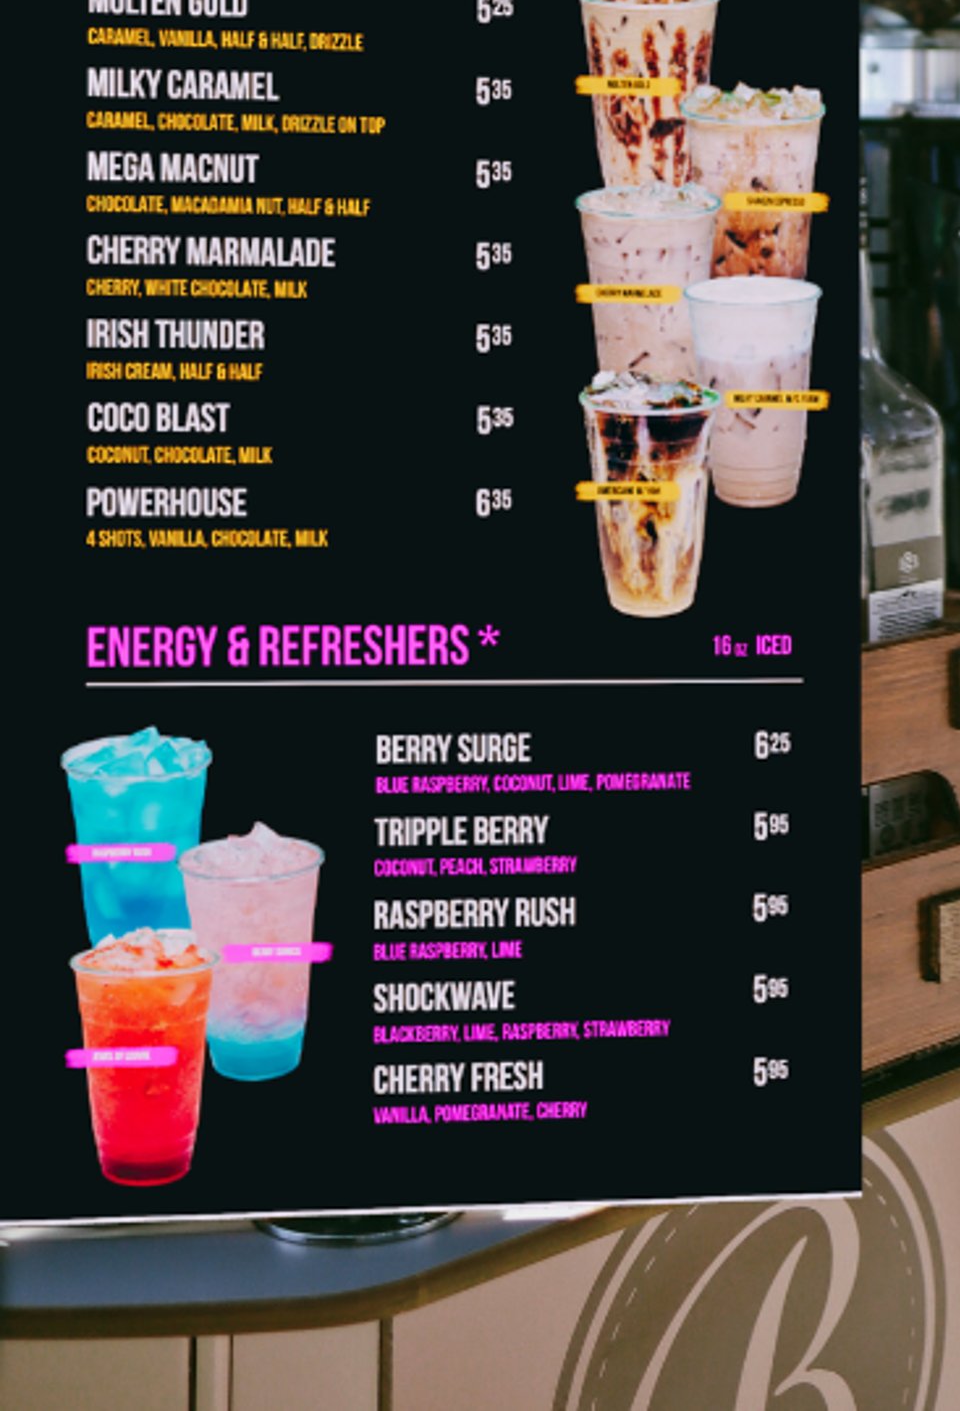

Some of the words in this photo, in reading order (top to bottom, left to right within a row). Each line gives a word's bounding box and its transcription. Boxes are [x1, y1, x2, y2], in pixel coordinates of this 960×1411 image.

[88, 27, 155, 47] CARAMEL,
[159, 30, 218, 49] VANILLA,
[221, 31, 254, 48] HALF
[258, 31, 268, 49] &
[270, 32, 306, 51] HALF,
[309, 32, 363, 51] DRIZZLE
[88, 67, 162, 99] MILKY
[167, 70, 280, 101] CARAMEL
[476, 77, 512, 105] 535
[86, 111, 155, 131] CARAMEL,
[158, 112, 238, 132] CHOCOLATE,
[241, 114, 278, 134] MILK,
[282, 115, 335, 133] DRIZZLE
[338, 116, 356, 133] ON
[359, 117, 385, 134] TOP
[88, 151, 155, 182] MEGA
[160, 153, 259, 183] MACNUT
[476, 159, 512, 188] 535
[86, 195, 168, 214] CHOCOLATE,
[171, 196, 253, 214] MACADAMIA
[256, 197, 285, 215] NUT,
[288, 198, 322, 215] HALF
[324, 198, 335, 215] &
[337, 198, 370, 216] HALF
[87, 235, 181, 264] CHERRY
[186, 237, 335, 267] MARMALADE
[476, 242, 512, 270] 535
[86, 278, 142, 297] CHERRY,
[144, 279, 188, 296] WHITE
[190, 279, 271, 298] CHOCOLATE,
[274, 280, 307, 298] MILK
[87, 319, 149, 348] IRISH
[154, 319, 264, 349] THUNDER
[476, 324, 512, 353] 535
[86, 362, 123, 379] IRISH
[125, 362, 176, 381] CREAM,
[180, 363, 213, 380] HALF
[217, 363, 226, 380] &
[228, 363, 262, 380] HALF
[88, 402, 149, 432] COCO
[156, 402, 230, 432] BLAST
[477, 406, 514, 435] 535
[87, 446, 151, 463] COCONUT,
[154, 446, 236, 464] CHOCOLATE,
[238, 447, 272, 464] MILK
[87, 487, 247, 517] POWERHOUSE
[476, 488, 512, 517] 635
[86, 530, 96, 546] 4
[99, 529, 146, 547] SHOTS,
[149, 530, 208, 548] VANILLA,
[211, 529, 291, 548] CHOCOLATE,
[295, 530, 328, 547] MILK
[87, 625, 218, 668] ENERGY
[228, 625, 250, 667] &
[259, 624, 469, 666] REFRESHERS
[756, 634, 792, 655] ICED
[377, 734, 452, 764] BERRY
[458, 733, 531, 763] SURGE
[755, 730, 791, 759] 625
[376, 776, 409, 794] BLUE
[411, 775, 490, 793] RASPBERRY,
[493, 774, 556, 792] COCONUT,
[555, 774, 593, 792] LIME,
[596, 772, 690, 790] POMEGRANATE
[374, 816, 468, 846] TRIPPLE
[474, 815, 549, 845] BERRY
[754, 812, 789, 840] 595
[374, 858, 437, 877] COCONUT,
[440, 858, 487, 875] PEACH,
[374, 898, 509, 929] RASPBERRY
[515, 897, 575, 927] RUSH
[753, 893, 788, 922] 595
[374, 942, 406, 961] BLUE
[409, 942, 488, 959] RASPBERRY,
[492, 940, 522, 958] LIME
[374, 980, 515, 1013] SHOCKWAVE
[754, 974, 788, 1003] 595
[373, 1025, 461, 1044] BLACKBERRY,
[463, 1023, 499, 1042] LIME,
[502, 1022, 580, 1040] RASPBERRY,
[583, 1019, 671, 1038] STRAWBERRY
[374, 1063, 465, 1094] CHERRY
[471, 1061, 543, 1092] FRESH
[754, 1057, 788, 1086] 595
[373, 1106, 432, 1124] VANILLA,
[435, 1102, 534, 1122] POMEGRANATE,
[536, 1101, 587, 1119] CHERRY
